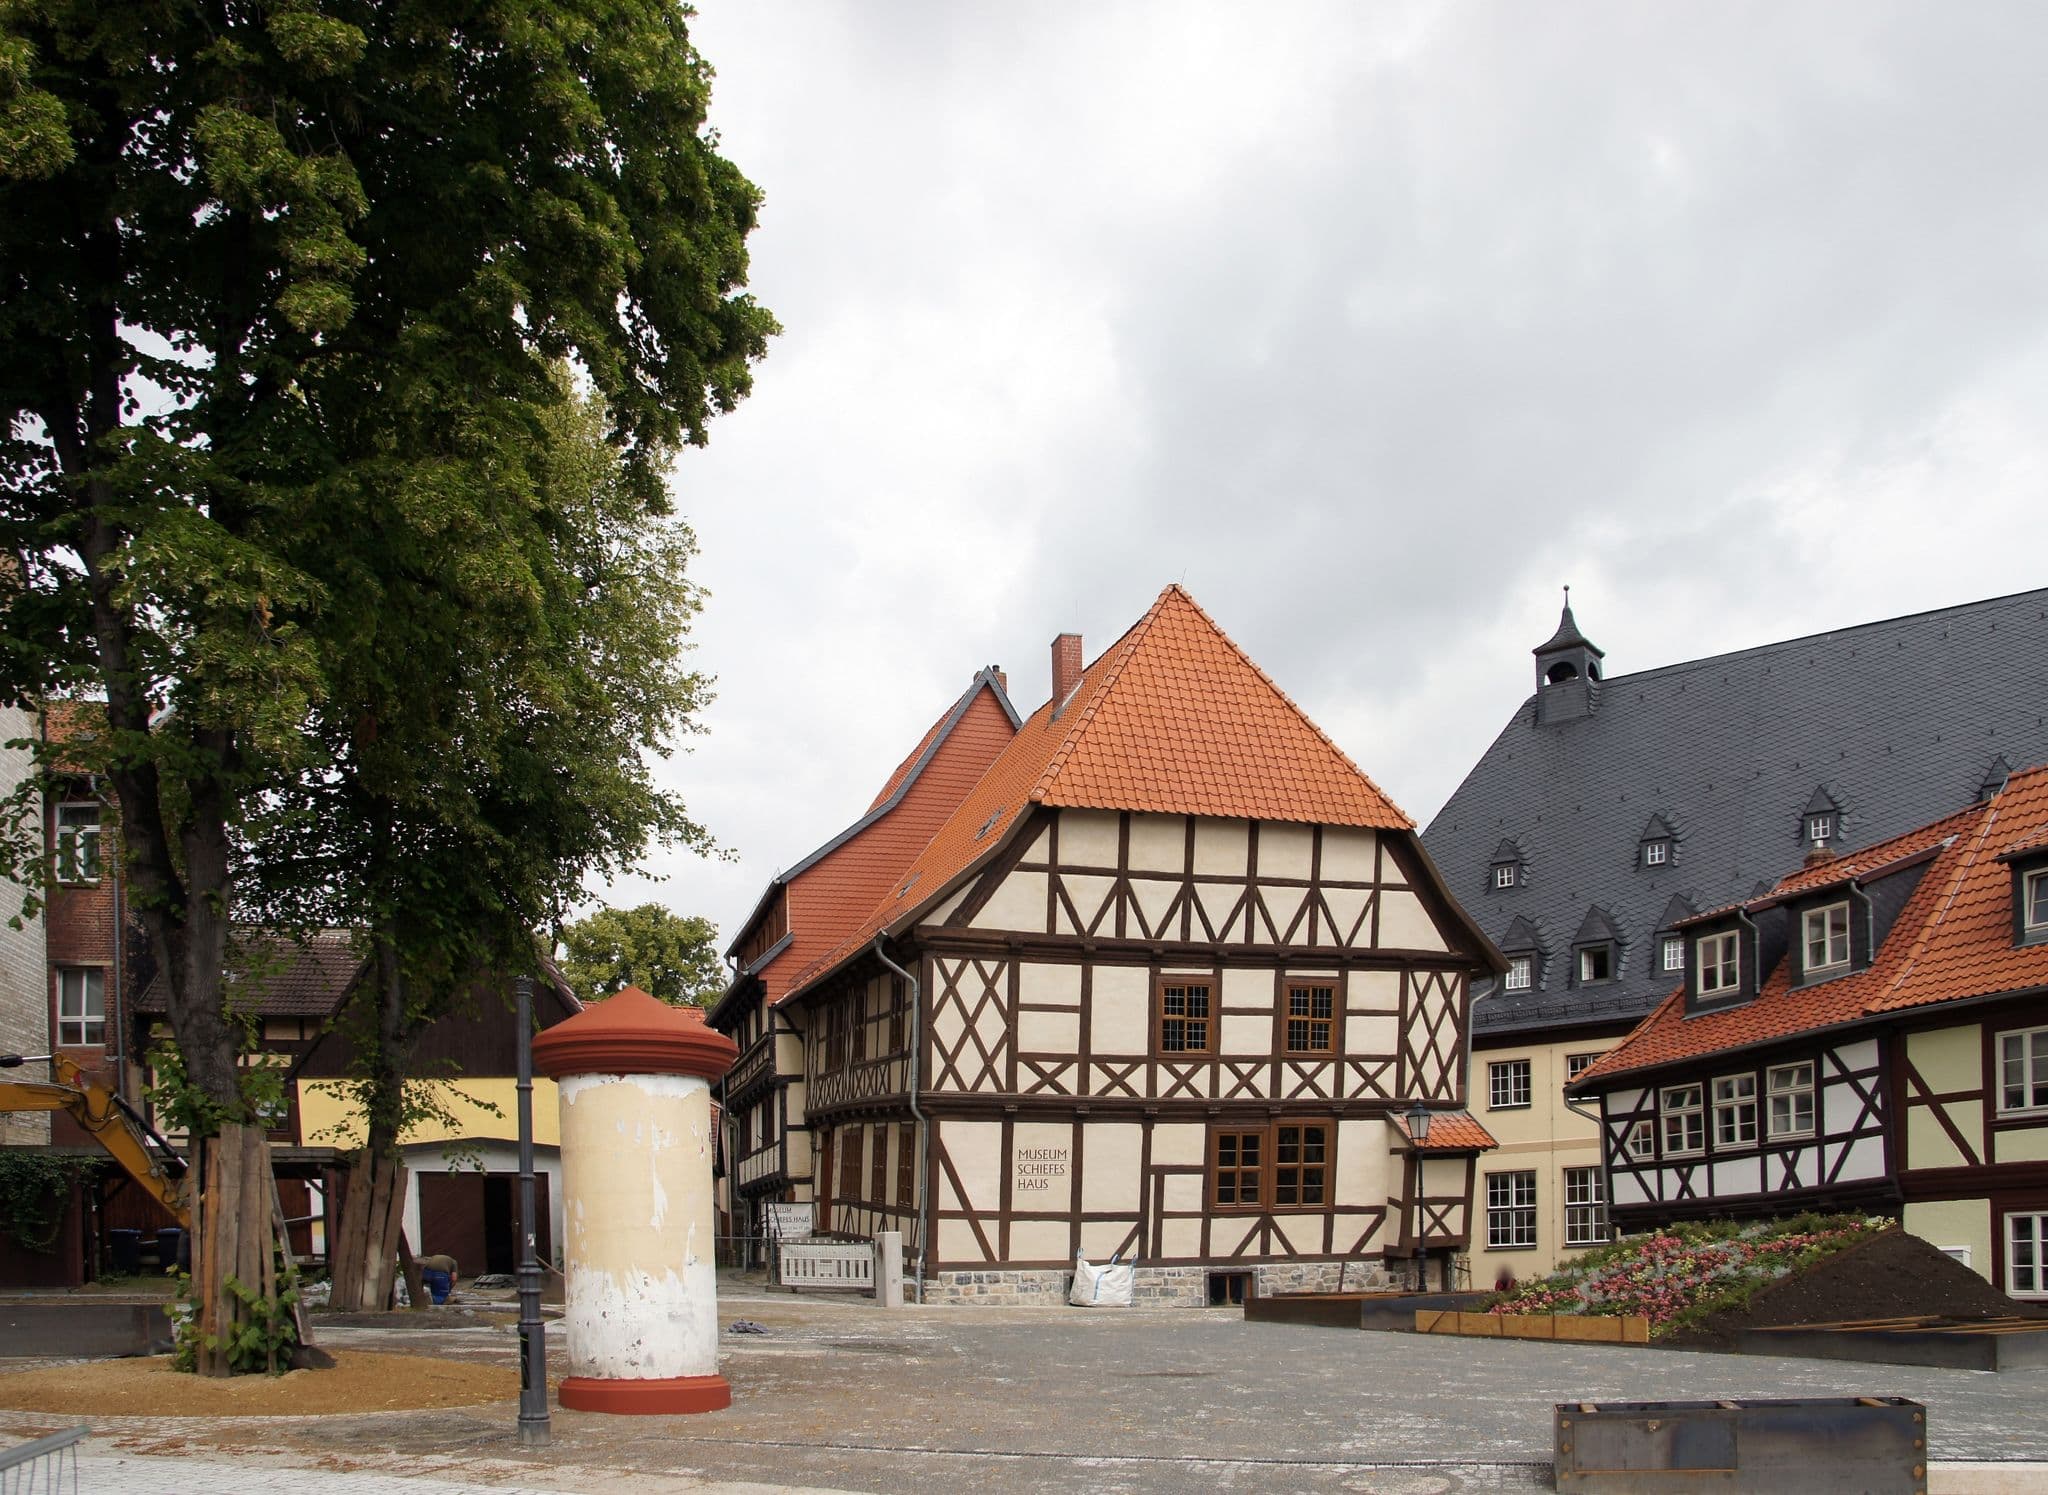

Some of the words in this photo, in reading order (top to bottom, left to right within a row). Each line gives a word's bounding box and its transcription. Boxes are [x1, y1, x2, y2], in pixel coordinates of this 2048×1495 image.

[1018, 1149, 1067, 1160] MUSEUM
[1017, 1163, 1065, 1175] SCHIEFES
[1017, 1178, 1049, 1189] HAUS
